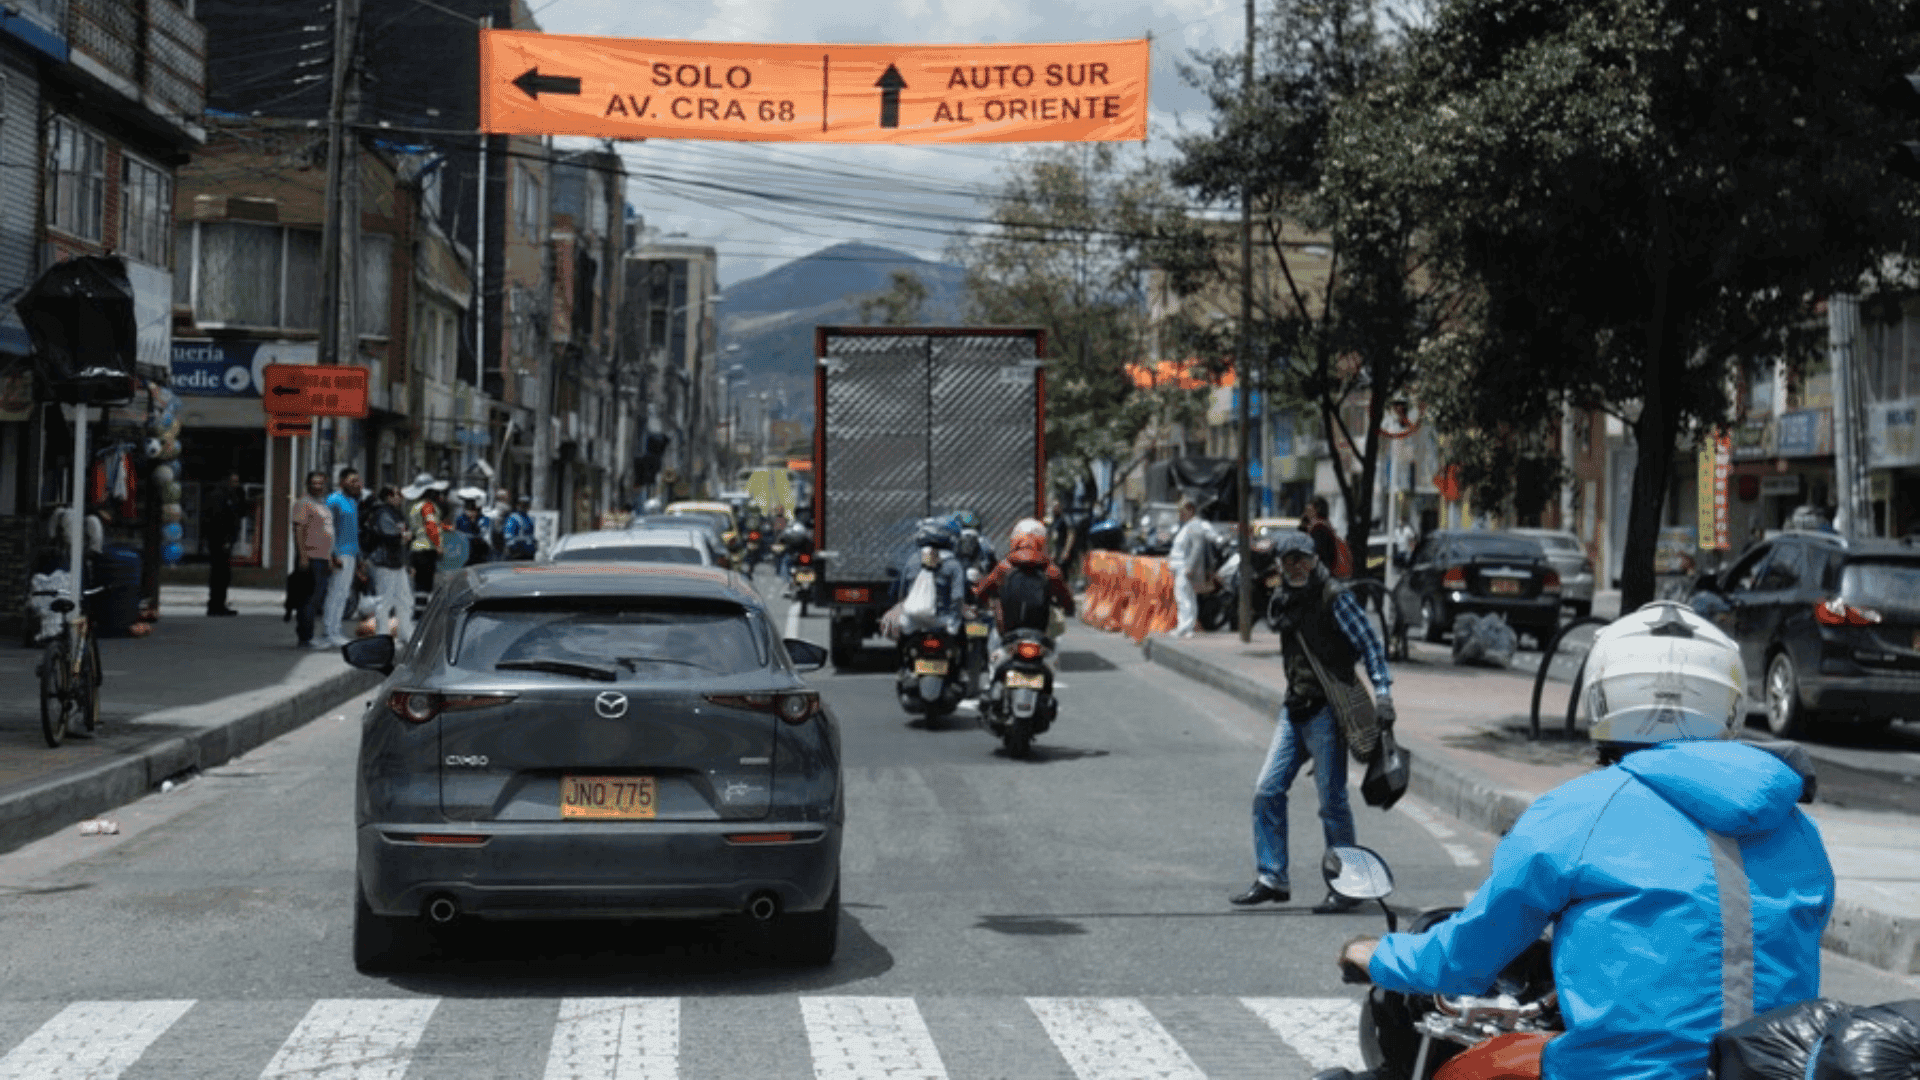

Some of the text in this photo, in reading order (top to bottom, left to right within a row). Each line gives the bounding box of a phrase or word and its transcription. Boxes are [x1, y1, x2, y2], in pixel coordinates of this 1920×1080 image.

[651, 63, 751, 89] SOLO
[948, 62, 1109, 89] AUTO SUR
[605, 94, 795, 122] AV. CRA 68
[933, 95, 1120, 123] AL ORIENTE
[171, 343, 224, 361] uería
[612, 782, 651, 806] 775
